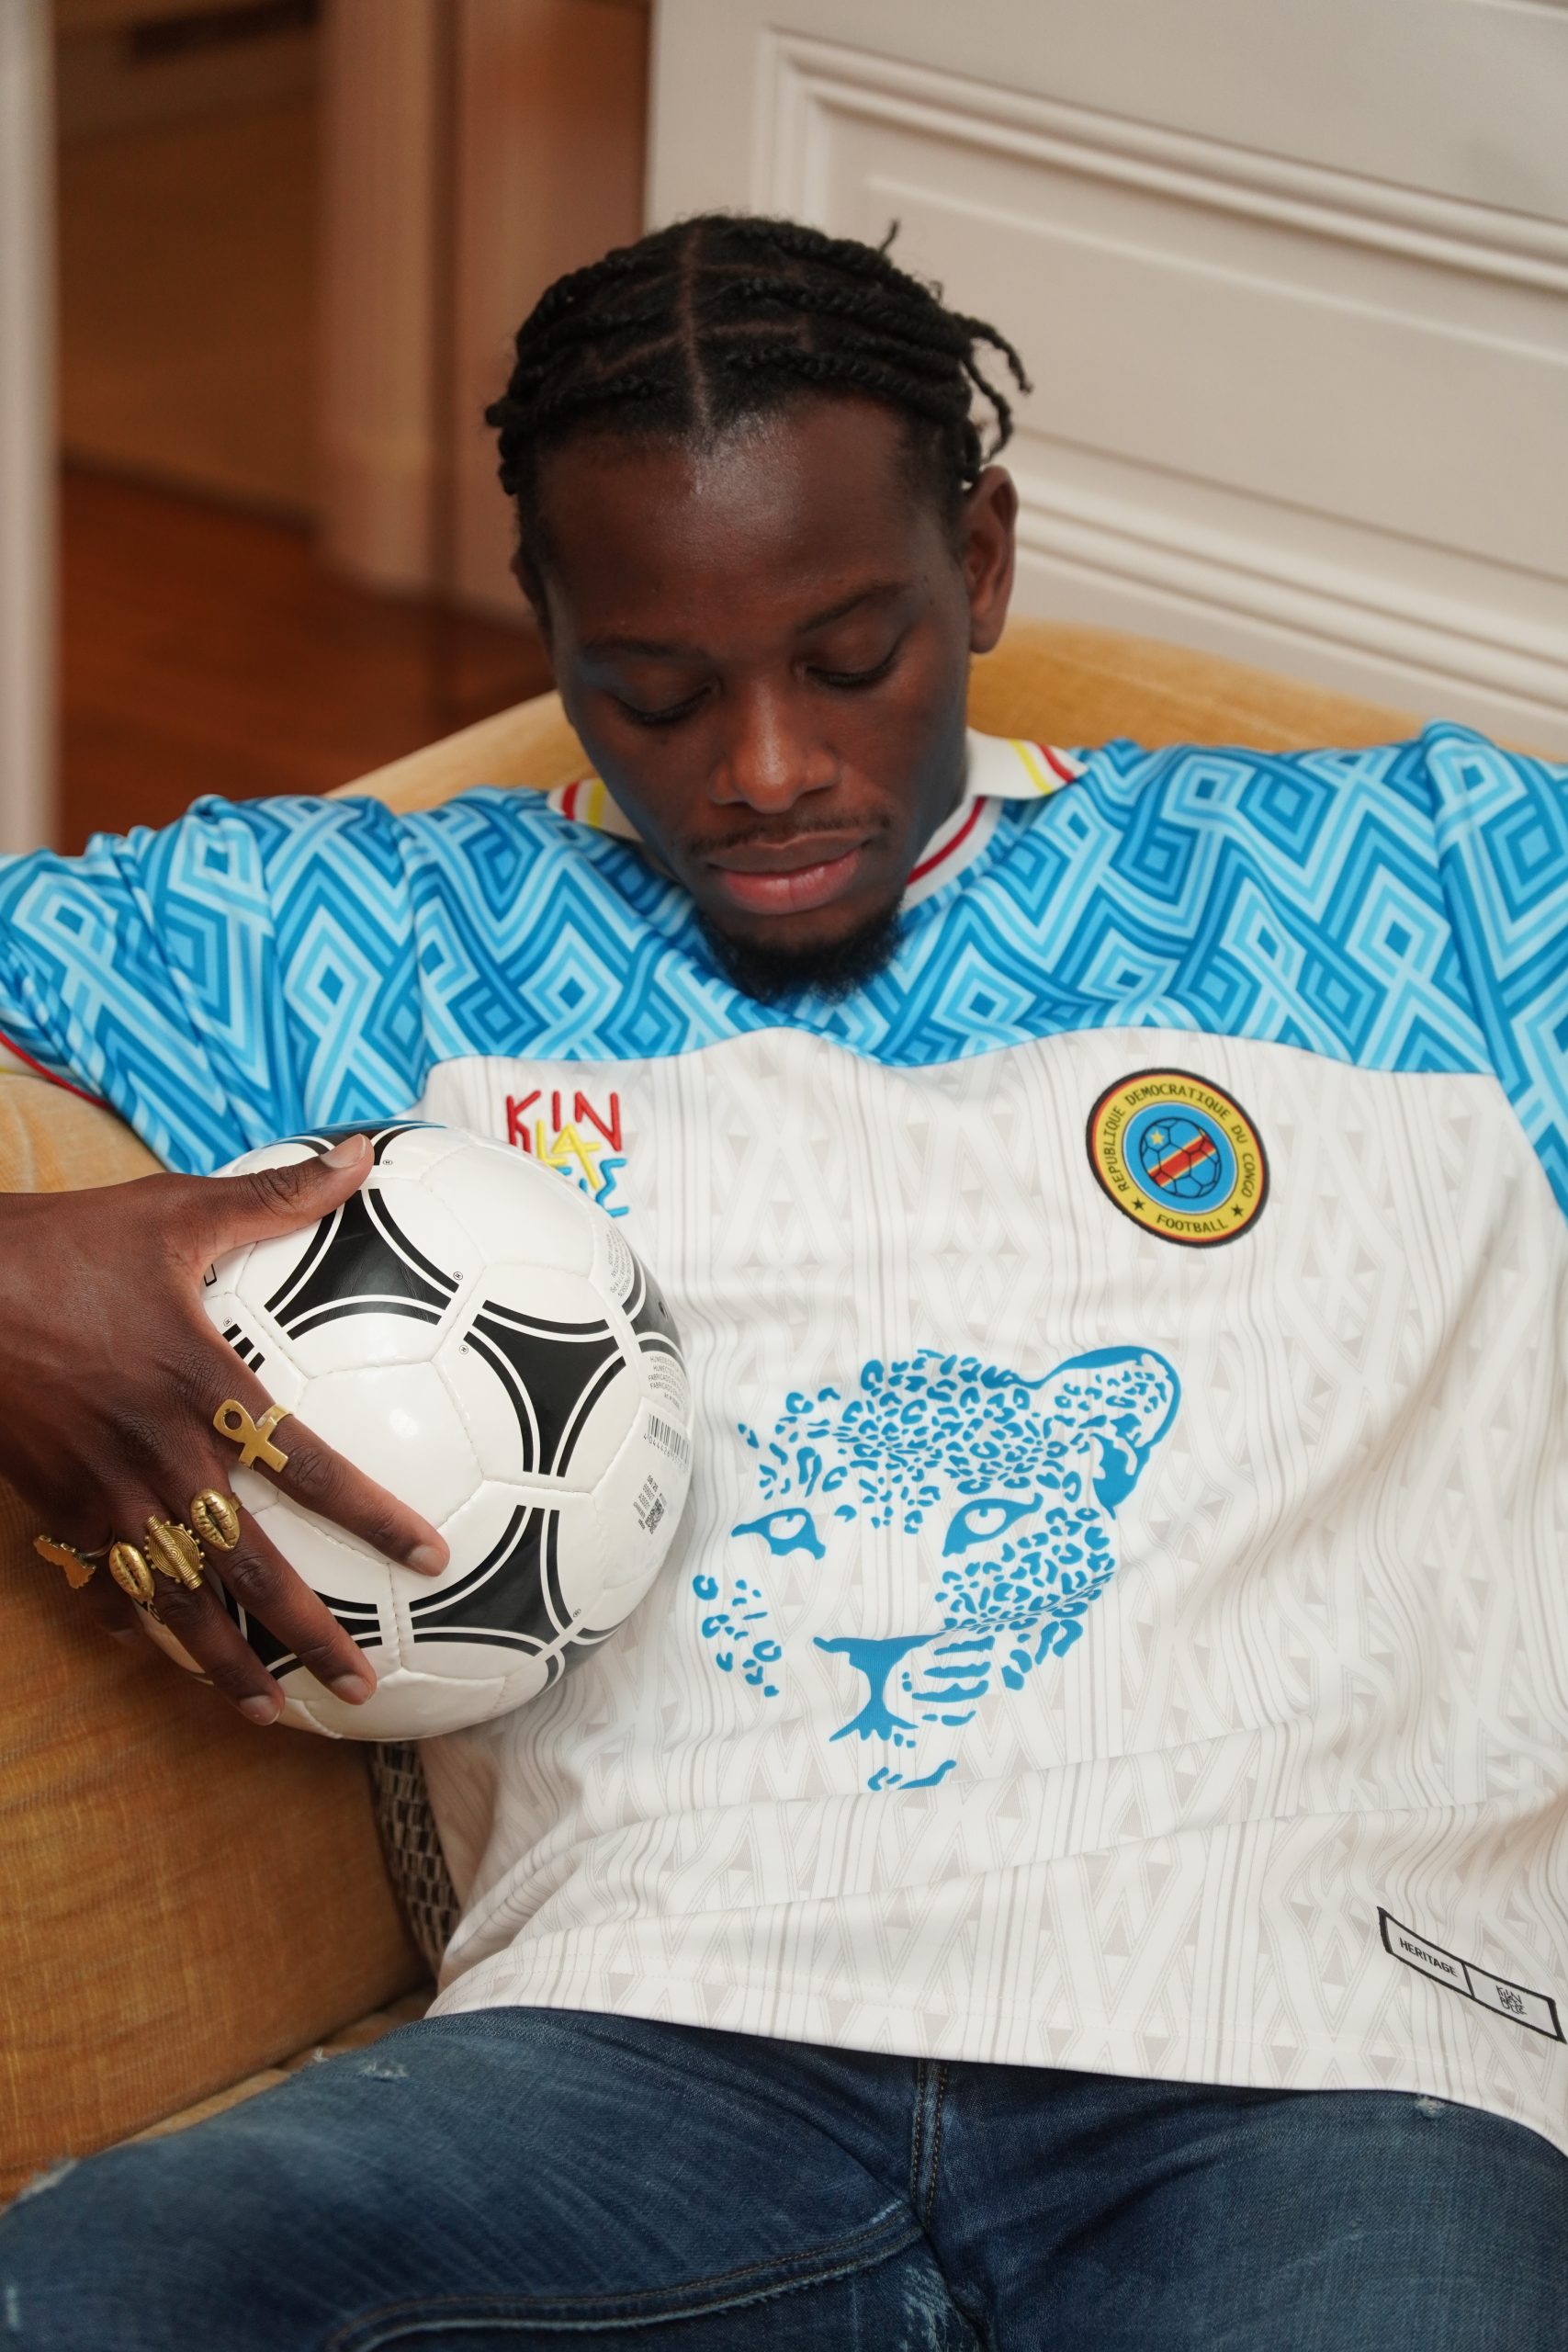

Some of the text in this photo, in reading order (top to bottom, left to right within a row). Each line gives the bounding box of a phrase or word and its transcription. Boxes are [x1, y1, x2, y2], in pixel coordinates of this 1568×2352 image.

[506, 1090, 623, 1154] KIN
[536, 1119, 602, 1189] LA
[1103, 1083, 1256, 1198] REPUBLIQUE DEMOCRATIQUE DU CONGO
[1156, 1213, 1229, 1233] FOOTBALL
[1399, 1937, 1459, 1977] HERITAGE
